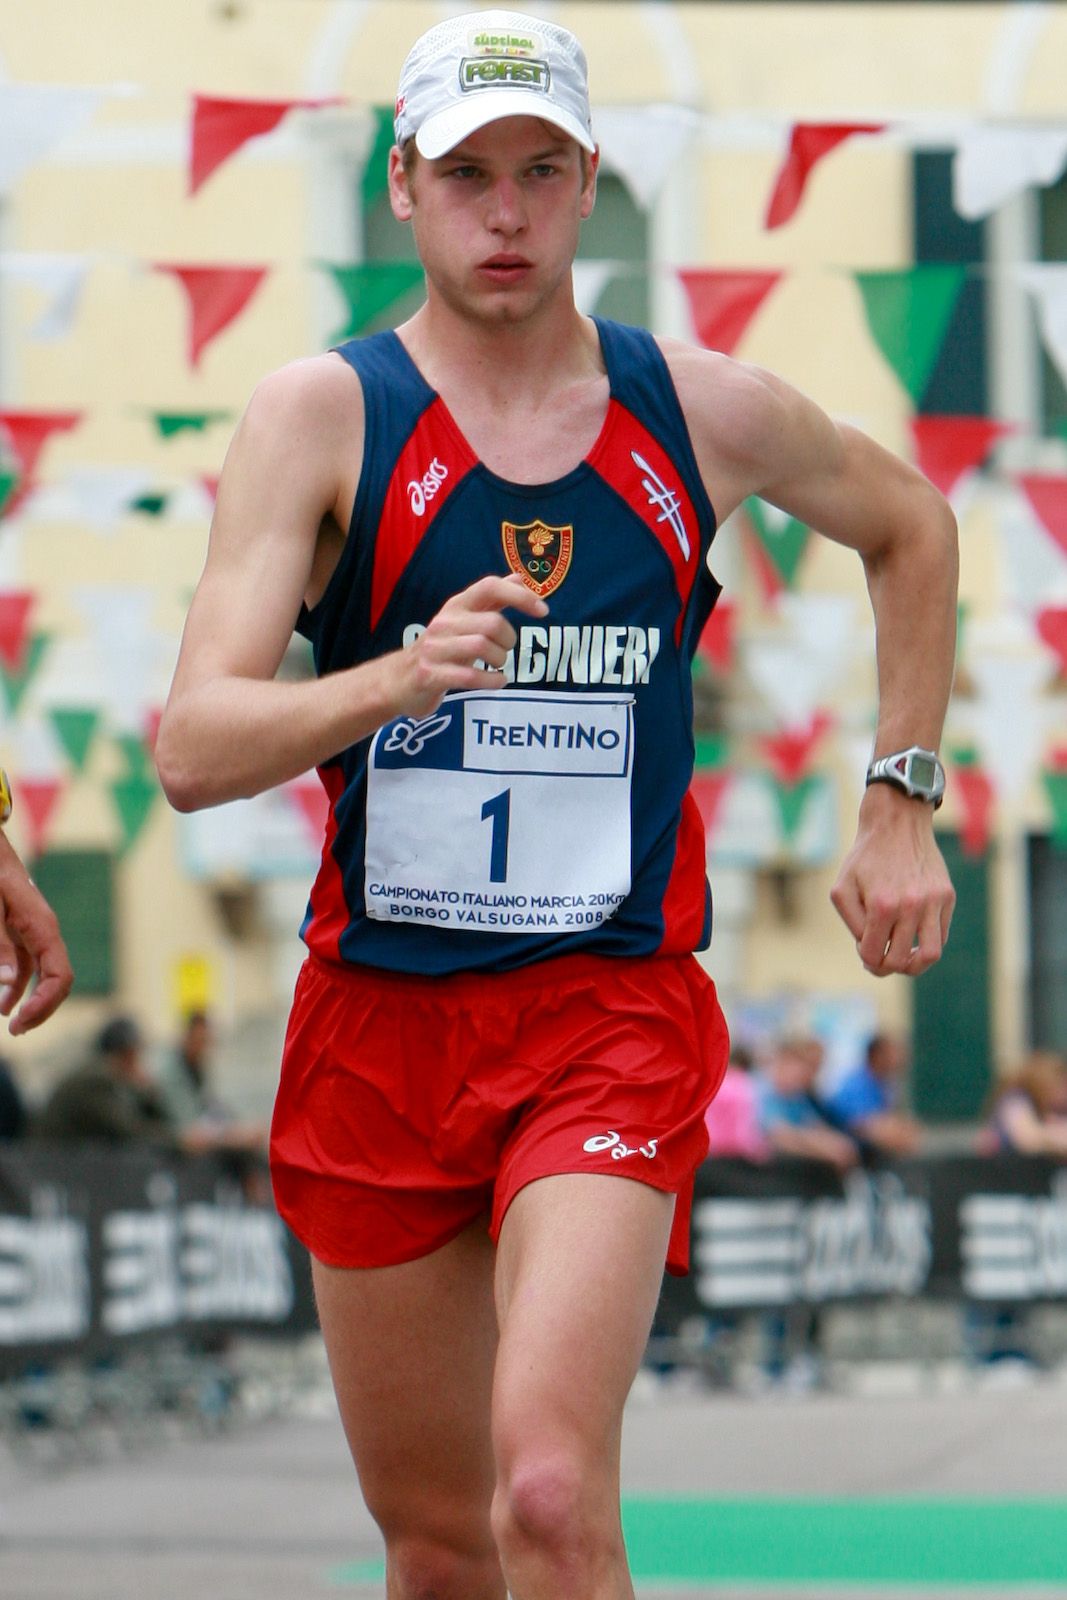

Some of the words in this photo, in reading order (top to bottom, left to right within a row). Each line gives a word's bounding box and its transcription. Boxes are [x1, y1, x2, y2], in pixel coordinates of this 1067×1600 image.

[481, 787, 511, 883] 1
[369, 883, 460, 904] CAMPIONATO
[463, 892, 527, 908] ITALIANO
[530, 895, 585, 908] MARCIA
[390, 904, 450, 921] BORGO
[456, 909, 558, 926] VALSUGANA
[565, 911, 603, 925] 2008
